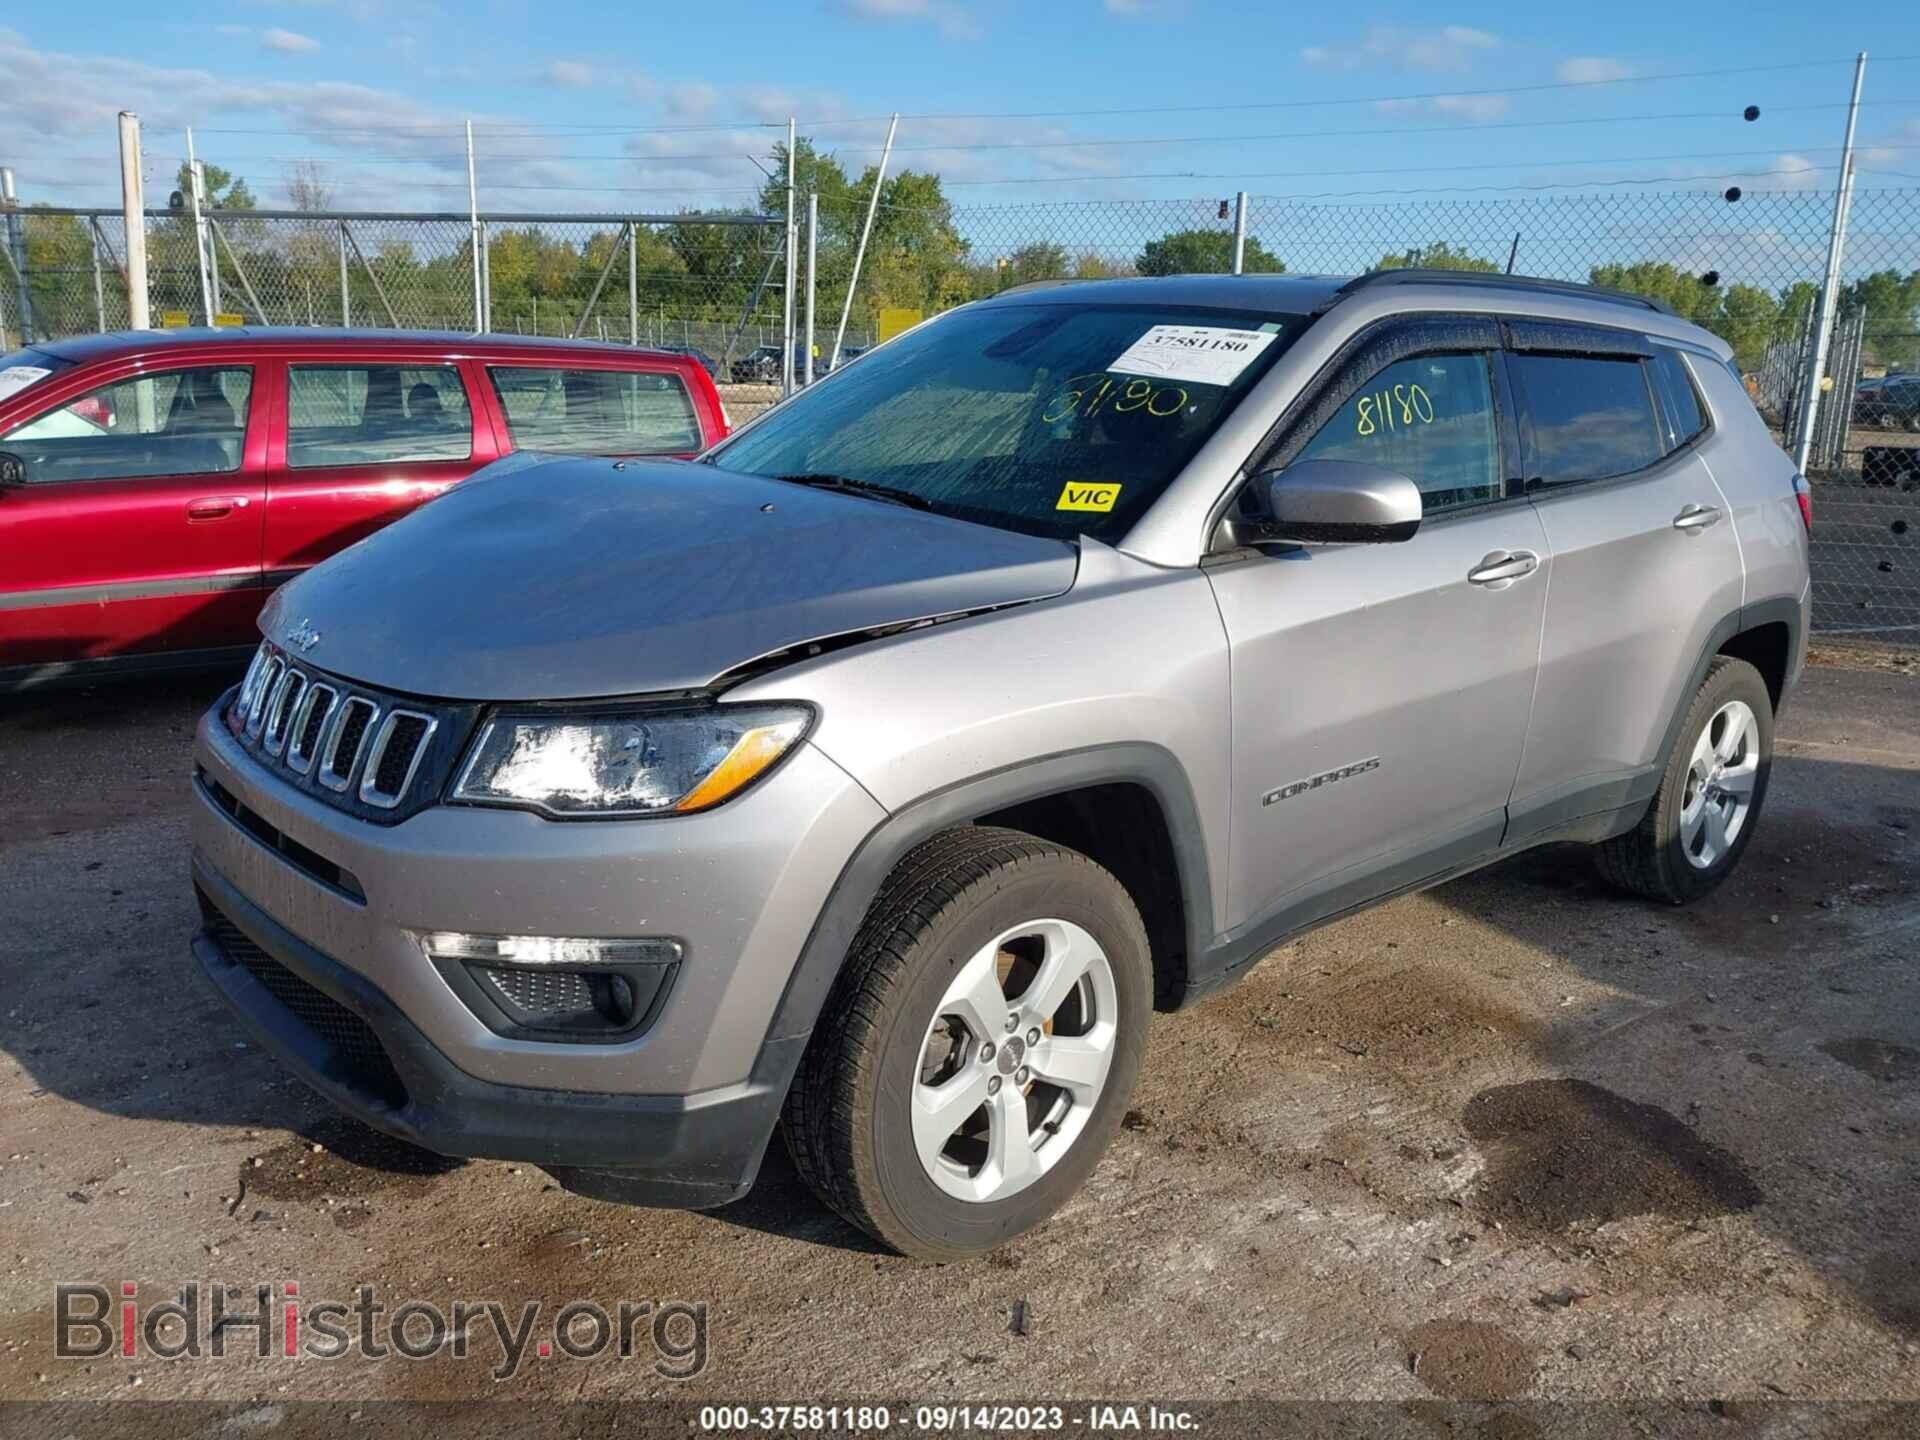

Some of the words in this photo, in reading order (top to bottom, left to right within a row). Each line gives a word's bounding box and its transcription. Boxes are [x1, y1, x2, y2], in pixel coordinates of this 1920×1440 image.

[1148, 335, 1249, 353] 37581180
[1357, 384, 1434, 436] 81180
[1068, 489, 1112, 505] VIC
[1262, 756, 1380, 808] COMPASS
